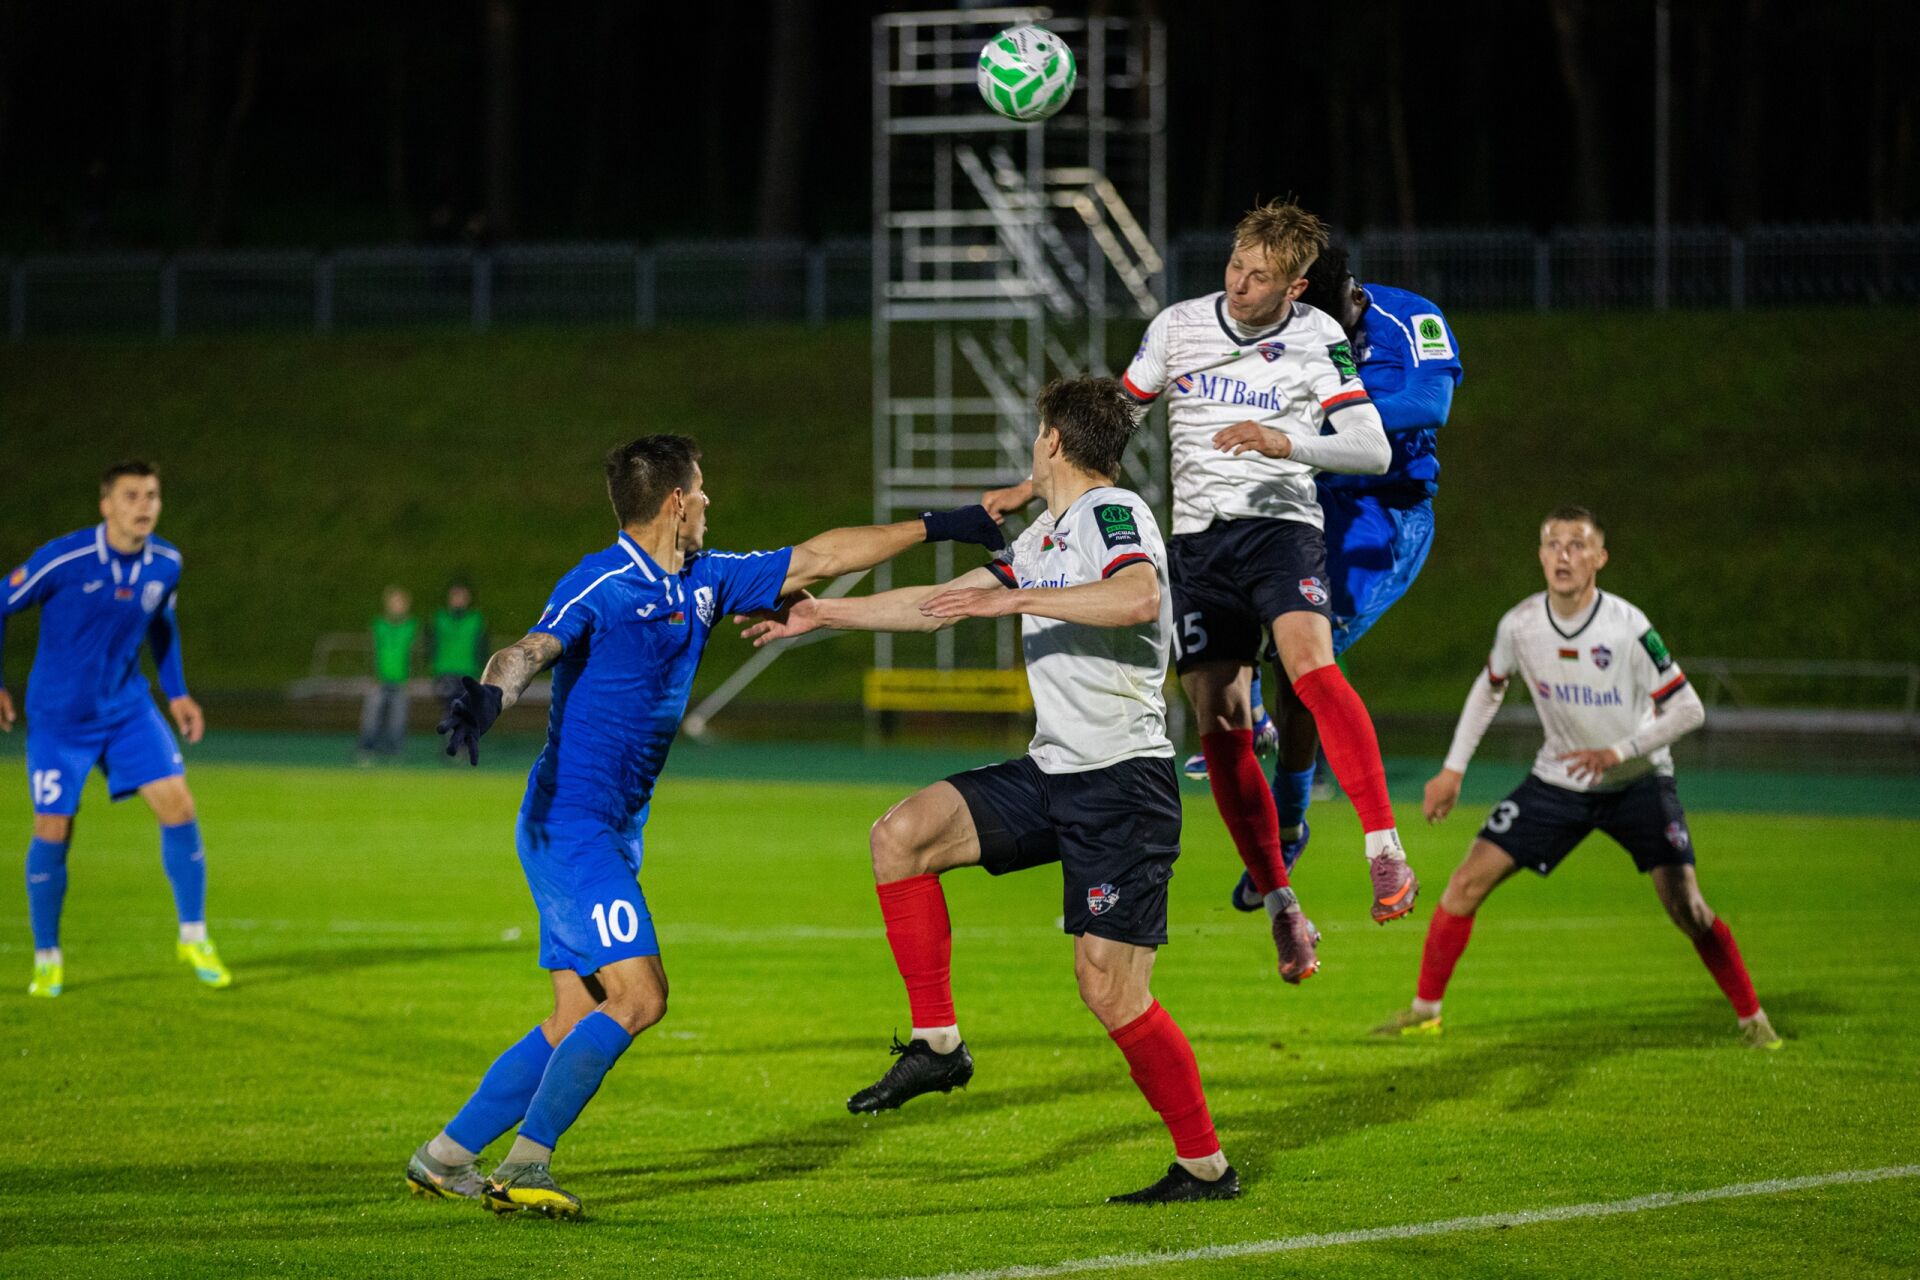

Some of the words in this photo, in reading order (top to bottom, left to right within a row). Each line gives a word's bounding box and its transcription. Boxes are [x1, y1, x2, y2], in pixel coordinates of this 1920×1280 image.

[1198, 373, 1282, 411] MTBank
[1555, 683, 1623, 706] MTBank
[33, 769, 62, 805] 15
[1487, 800, 1520, 834] 3
[591, 899, 639, 948] 10
